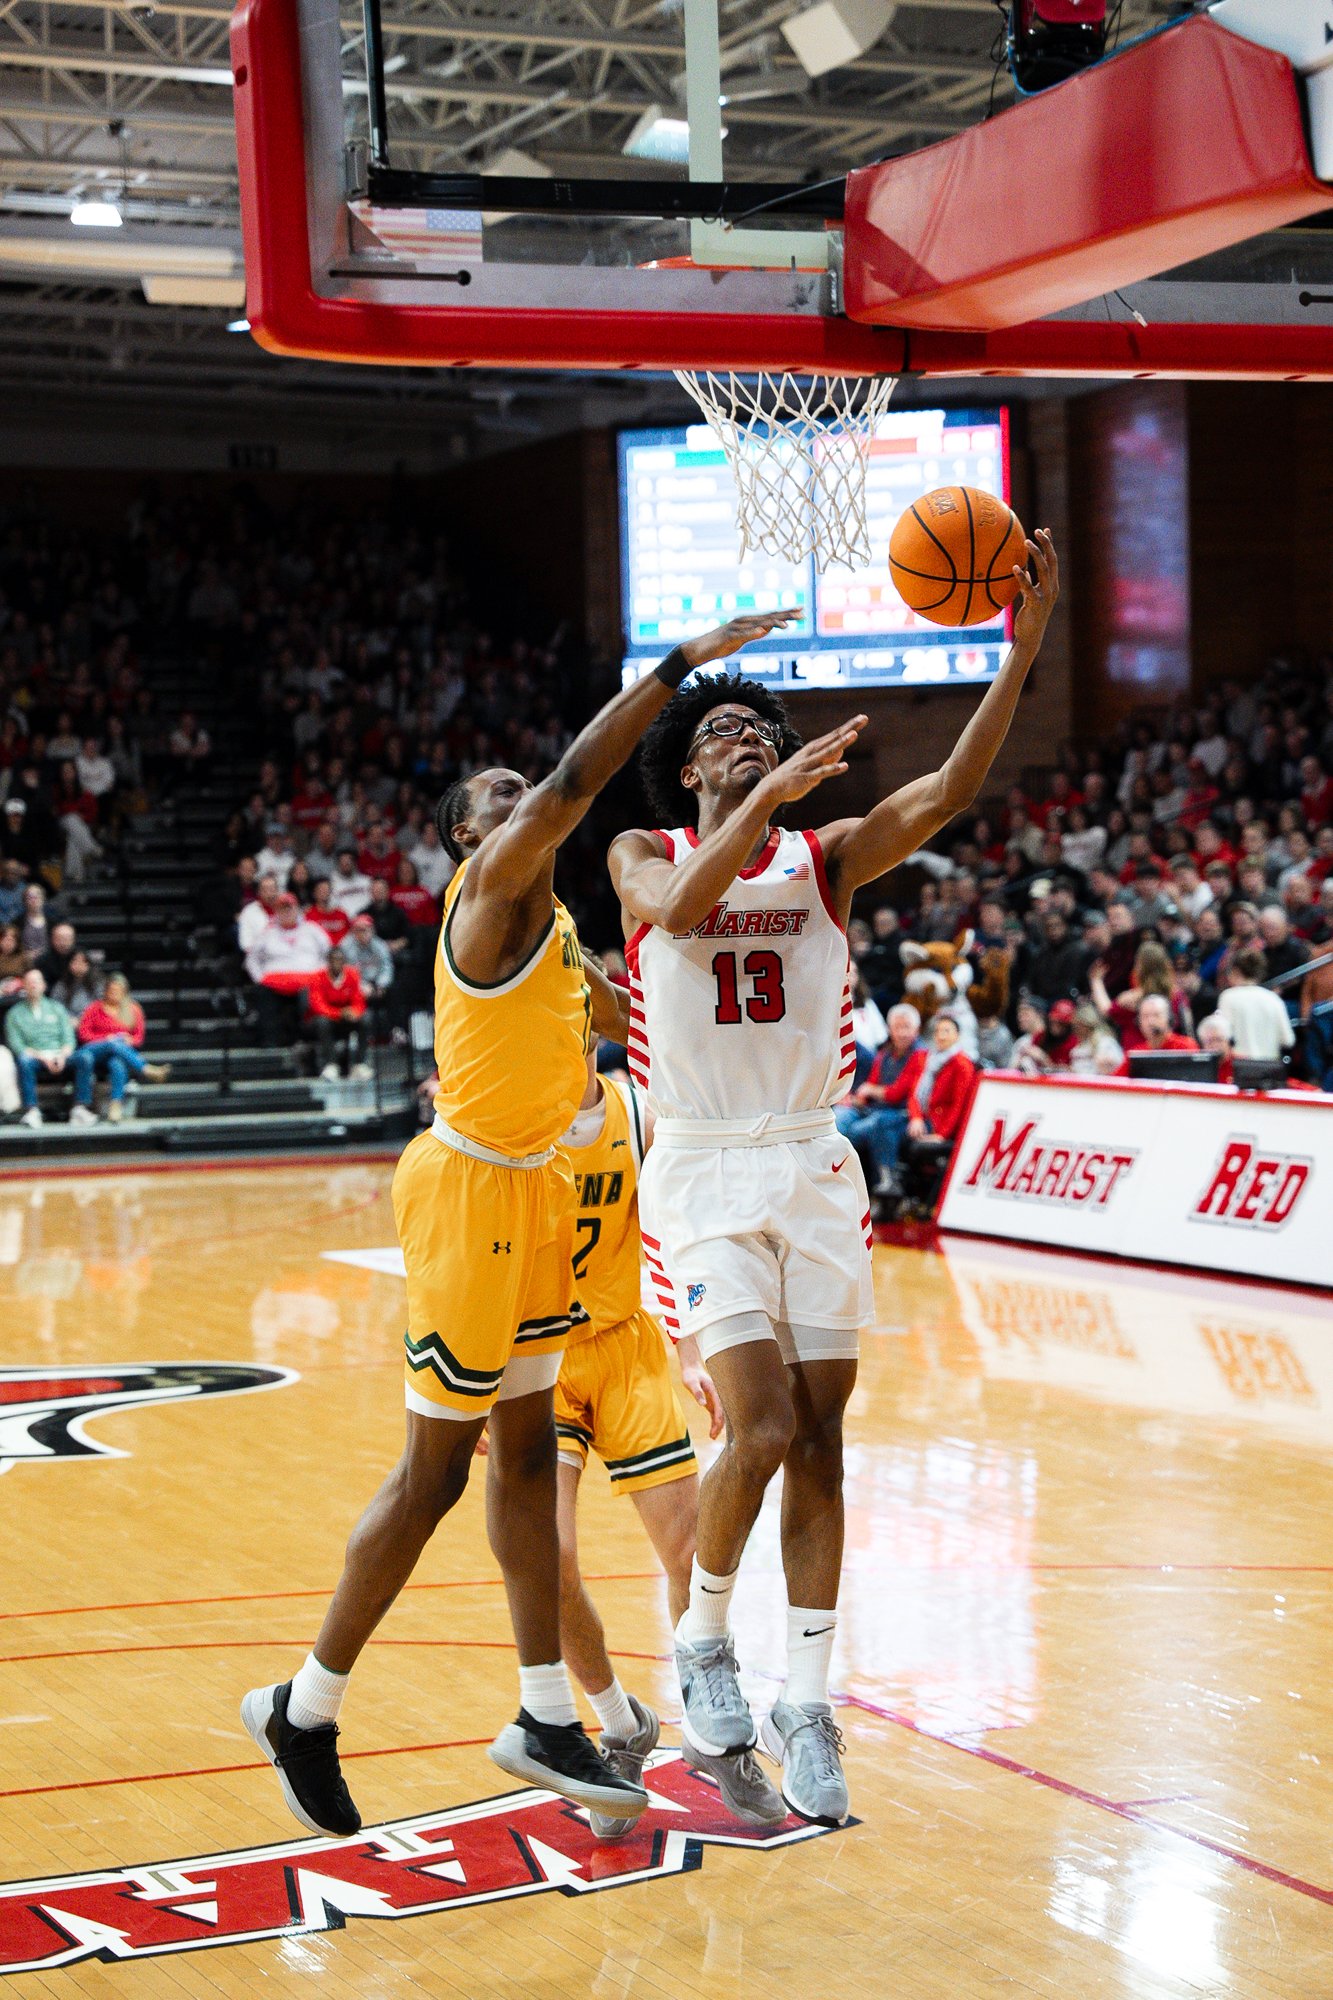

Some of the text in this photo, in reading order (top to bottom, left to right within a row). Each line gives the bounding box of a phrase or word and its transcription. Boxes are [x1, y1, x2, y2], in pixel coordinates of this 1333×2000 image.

[673, 902, 809, 938] MARIST
[712, 950, 786, 1025] 13
[958, 1111, 1315, 1233] MARIST RED
